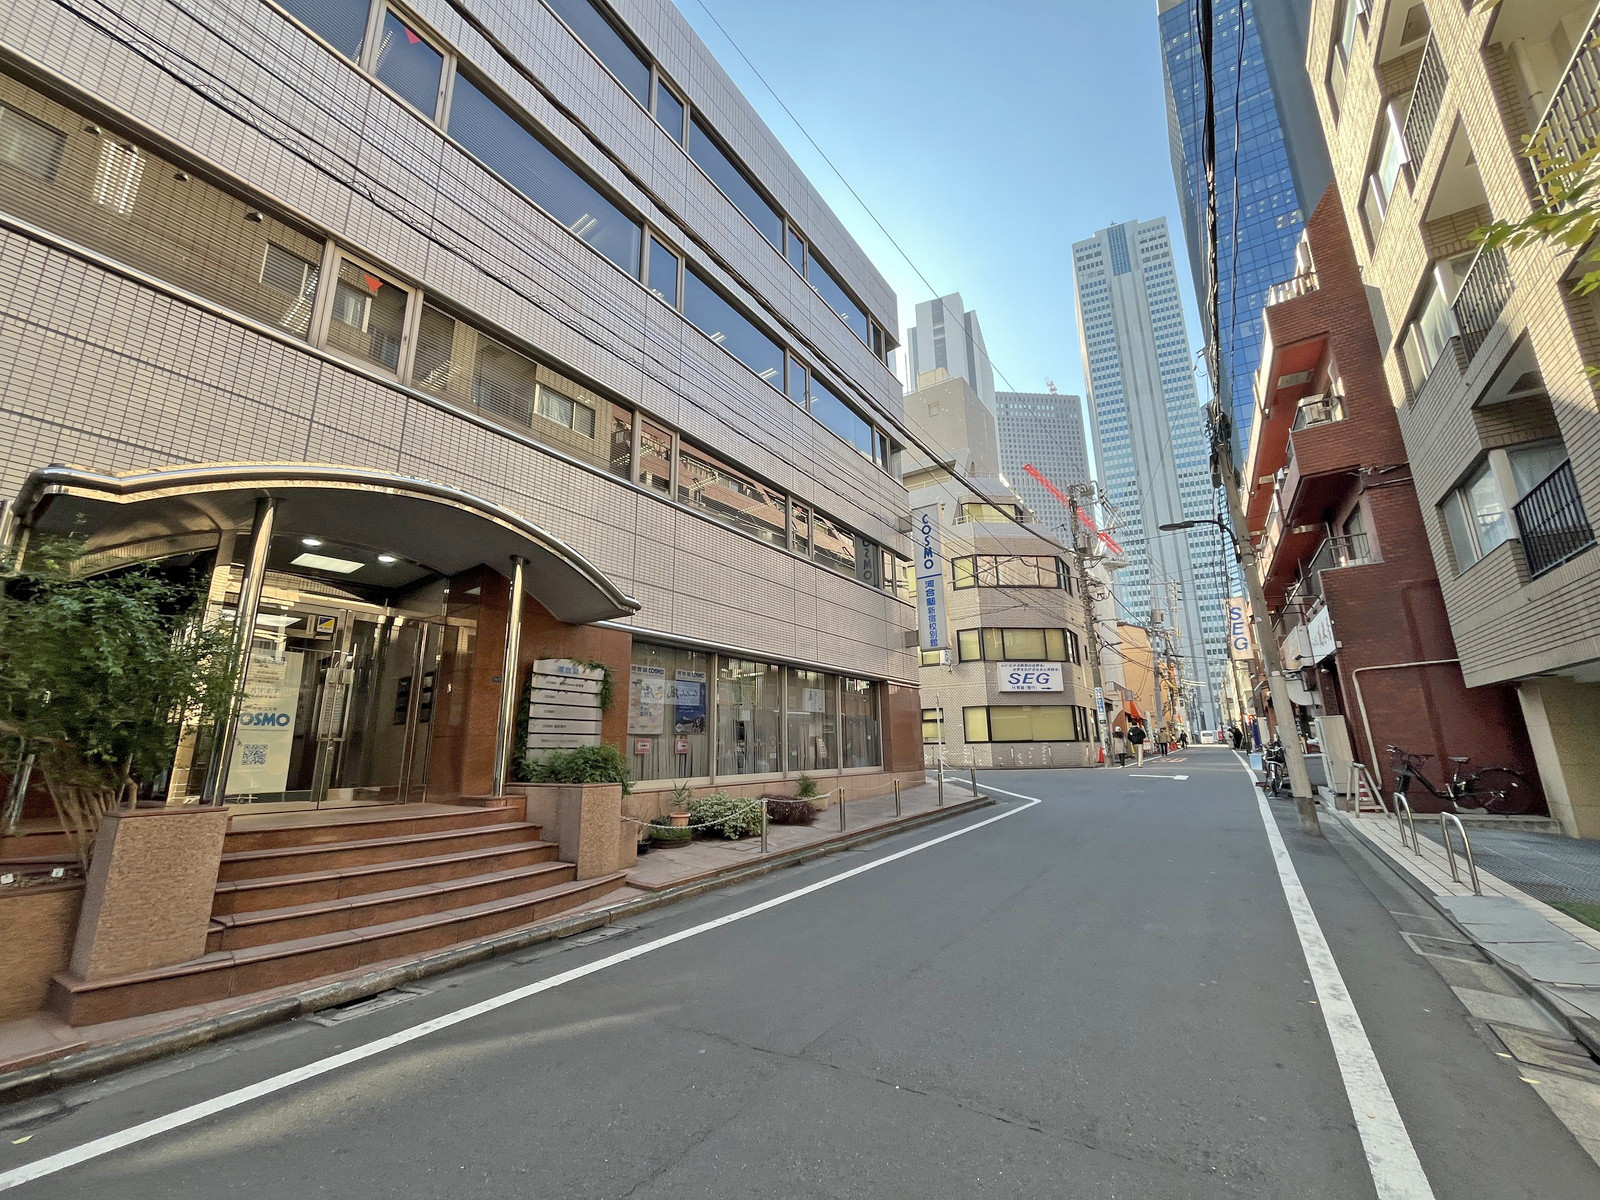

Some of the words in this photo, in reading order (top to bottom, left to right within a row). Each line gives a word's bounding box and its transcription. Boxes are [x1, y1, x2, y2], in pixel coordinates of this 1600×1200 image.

[922, 514, 934, 570] COSMO
[1230, 607, 1248, 650] SEG
[1008, 672, 1050, 685] SEG
[239, 712, 290, 727] OSMO
